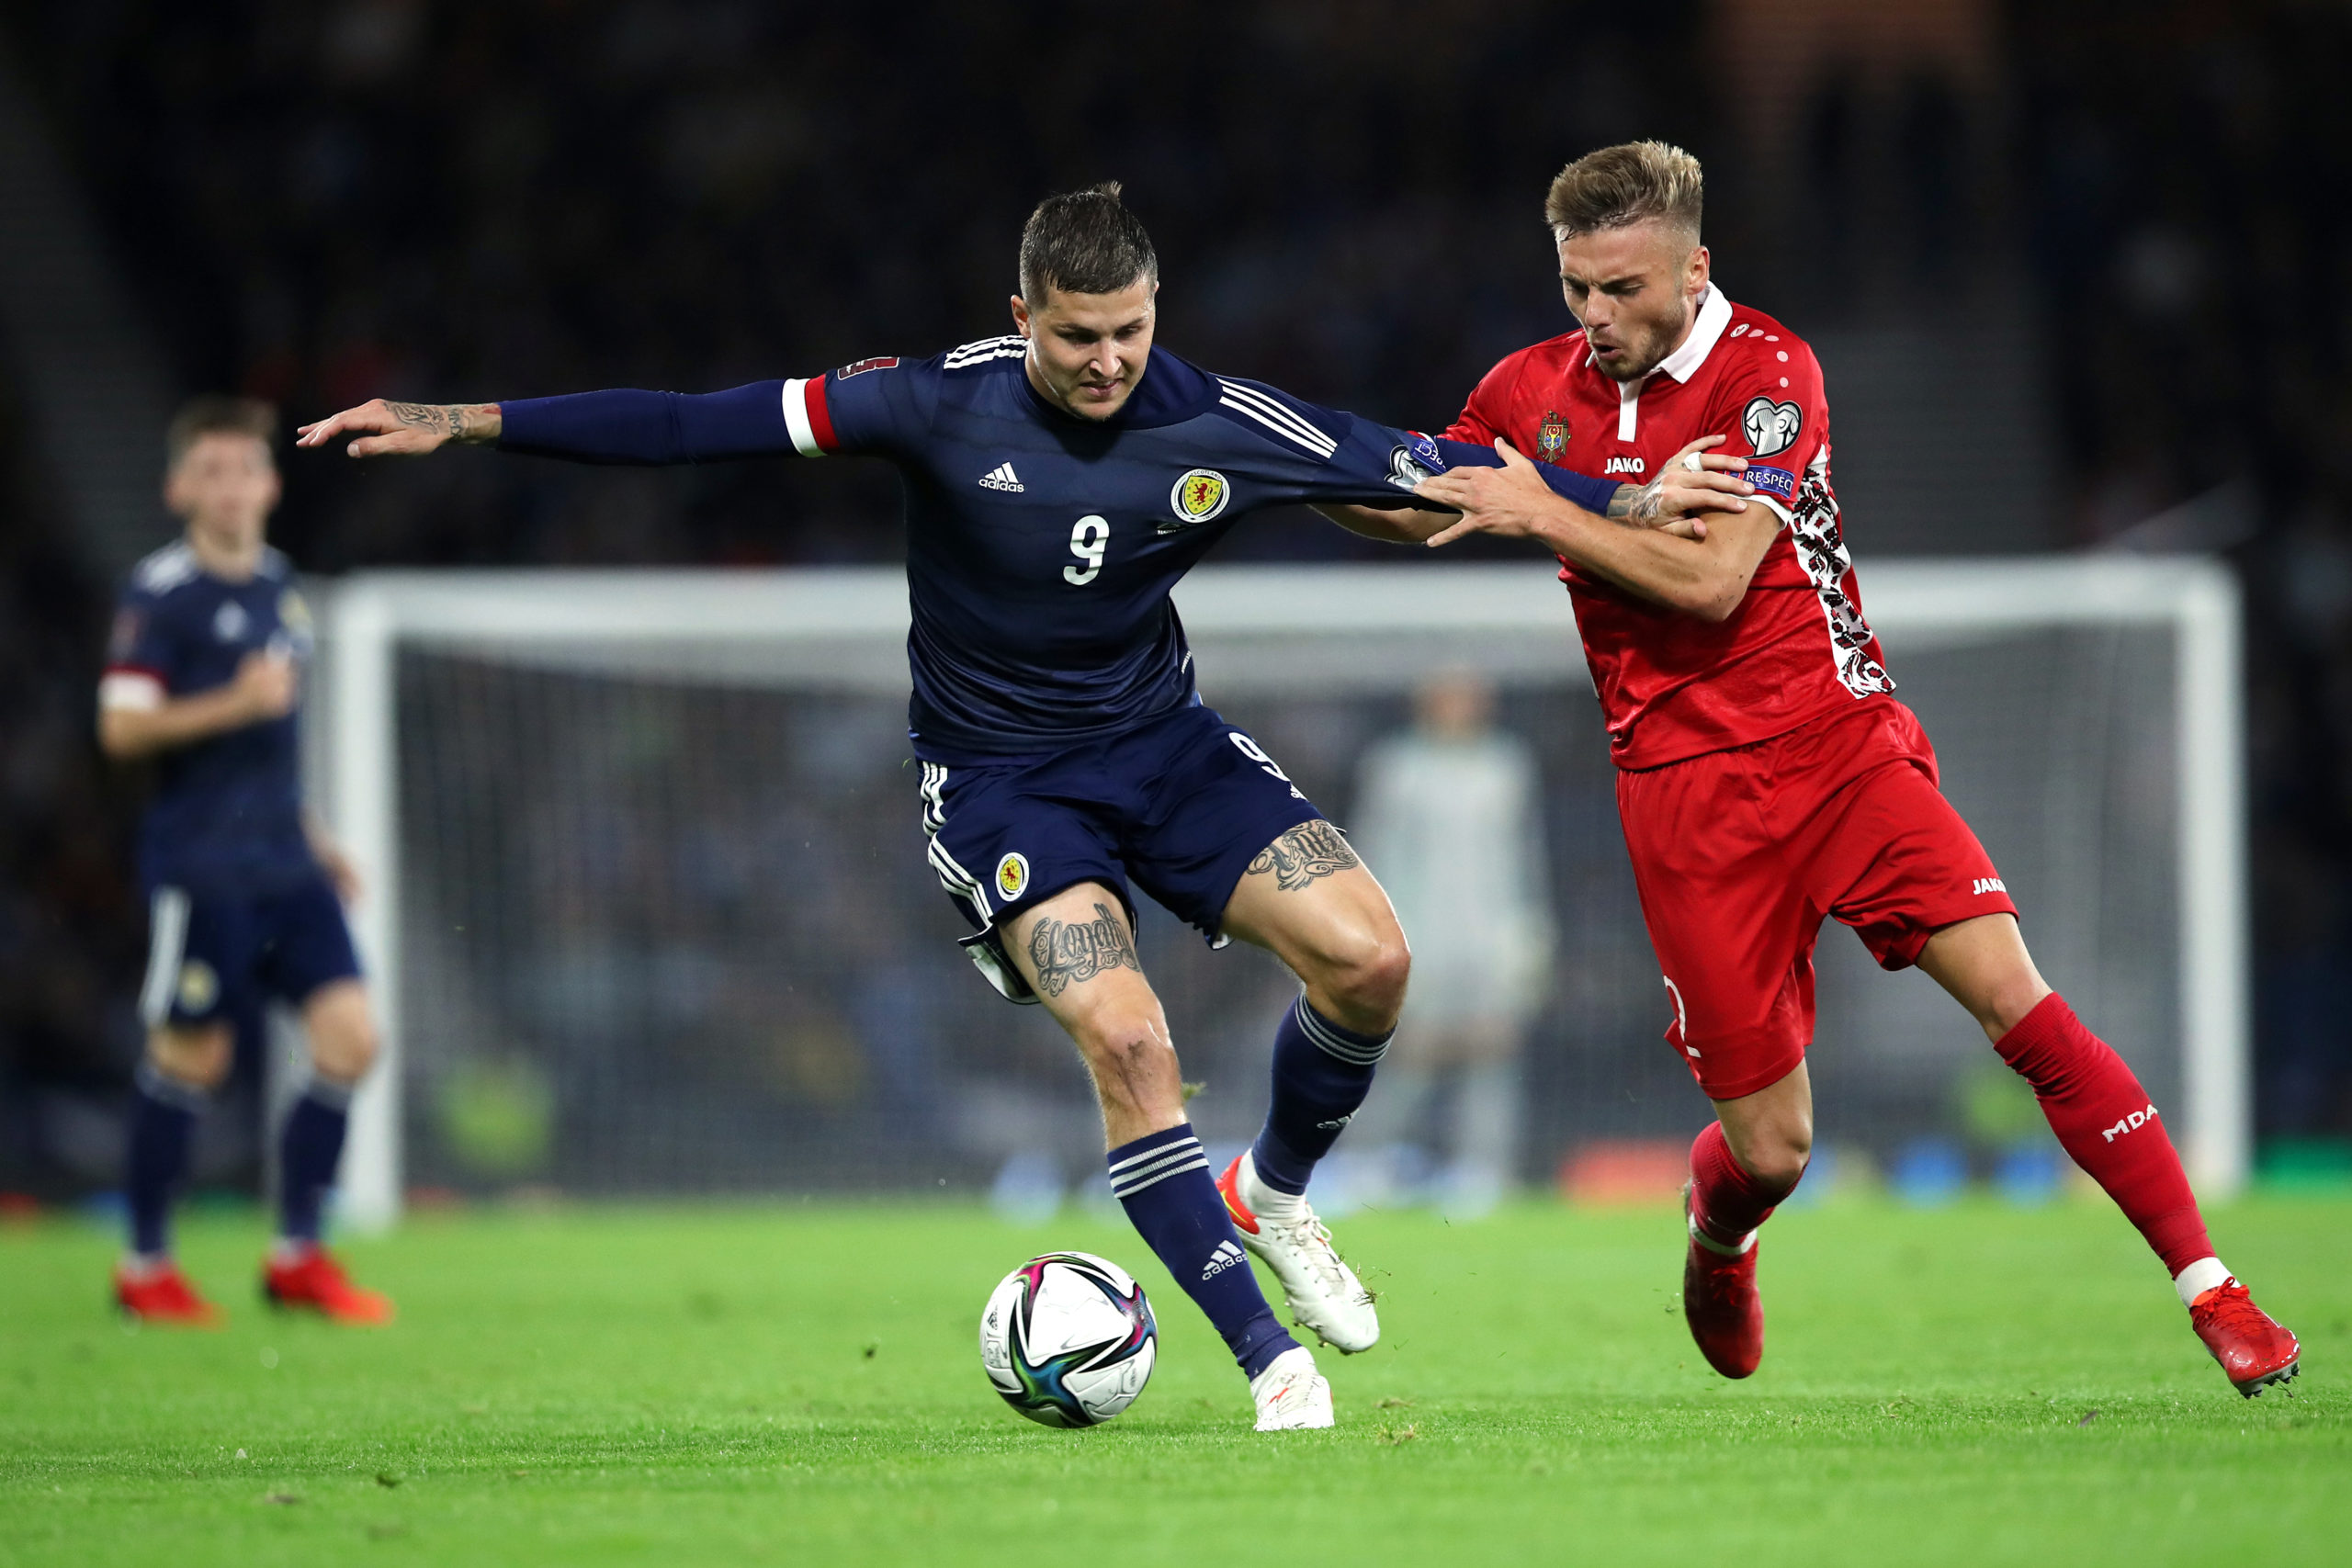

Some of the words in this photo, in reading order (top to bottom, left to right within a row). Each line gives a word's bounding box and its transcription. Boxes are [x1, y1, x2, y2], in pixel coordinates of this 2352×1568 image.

[1604, 457, 1645, 474] JAKO
[978, 479, 1024, 493] adidas
[1063, 514, 1110, 586] 9
[1228, 732, 1291, 782] 9
[2101, 1103, 2158, 1144] MDA
[1202, 1253, 1248, 1280] adidas
